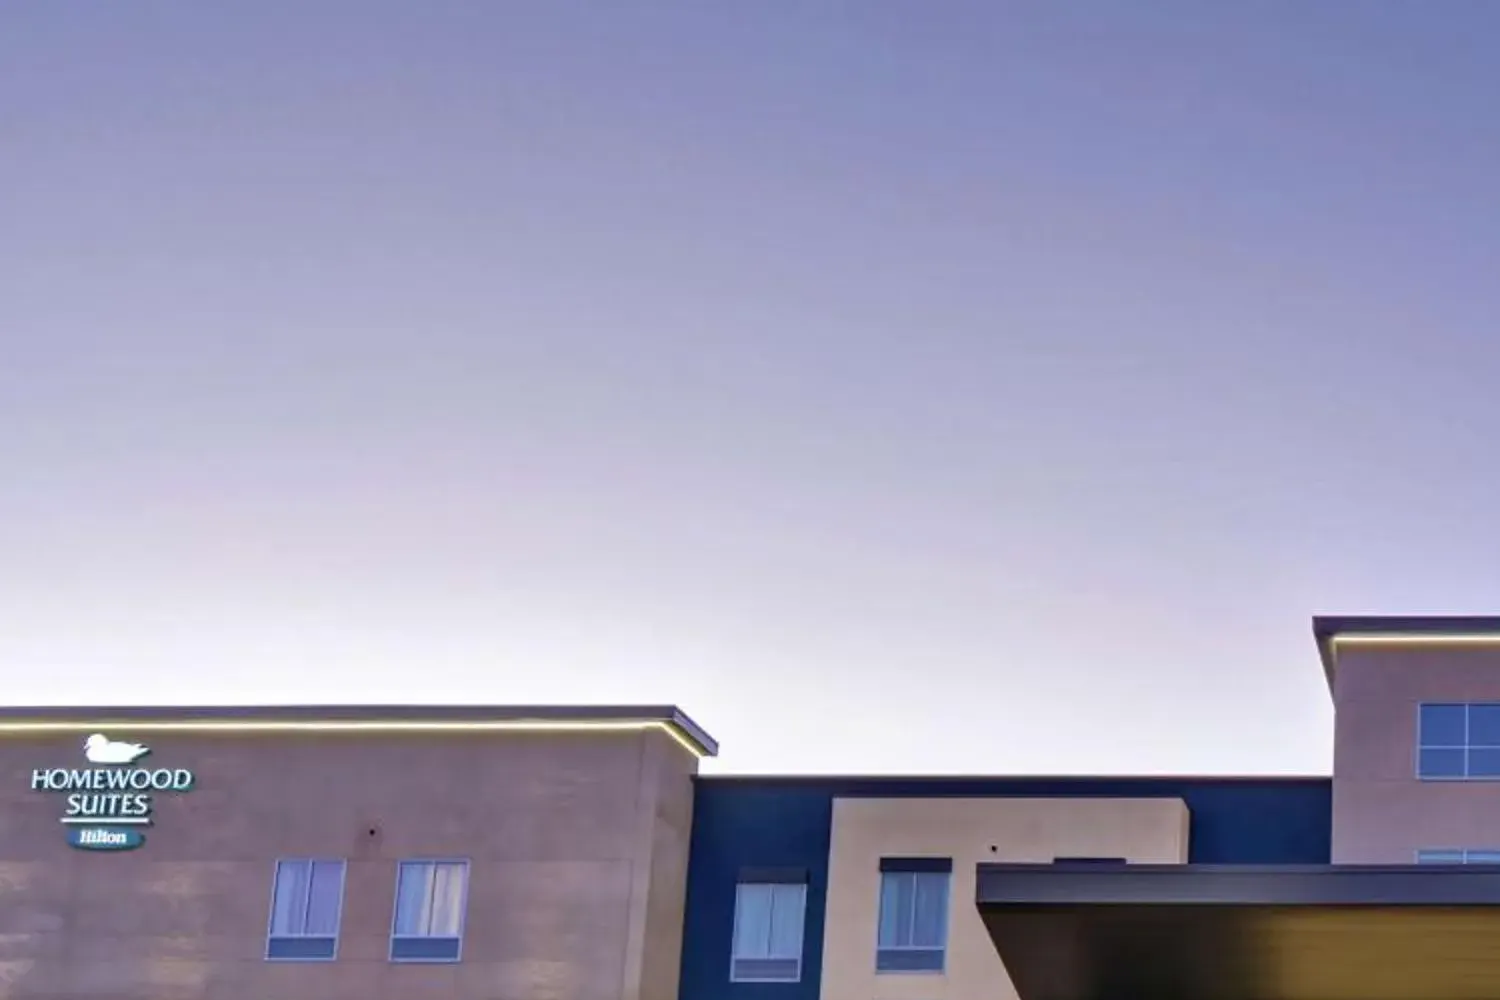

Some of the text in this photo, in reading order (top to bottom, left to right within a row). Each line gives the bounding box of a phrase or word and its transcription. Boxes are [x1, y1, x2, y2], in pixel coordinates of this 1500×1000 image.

[31, 768, 192, 789] HOMEWOOD
[65, 794, 148, 815] SUITES
[80, 829, 127, 844] Hilton
